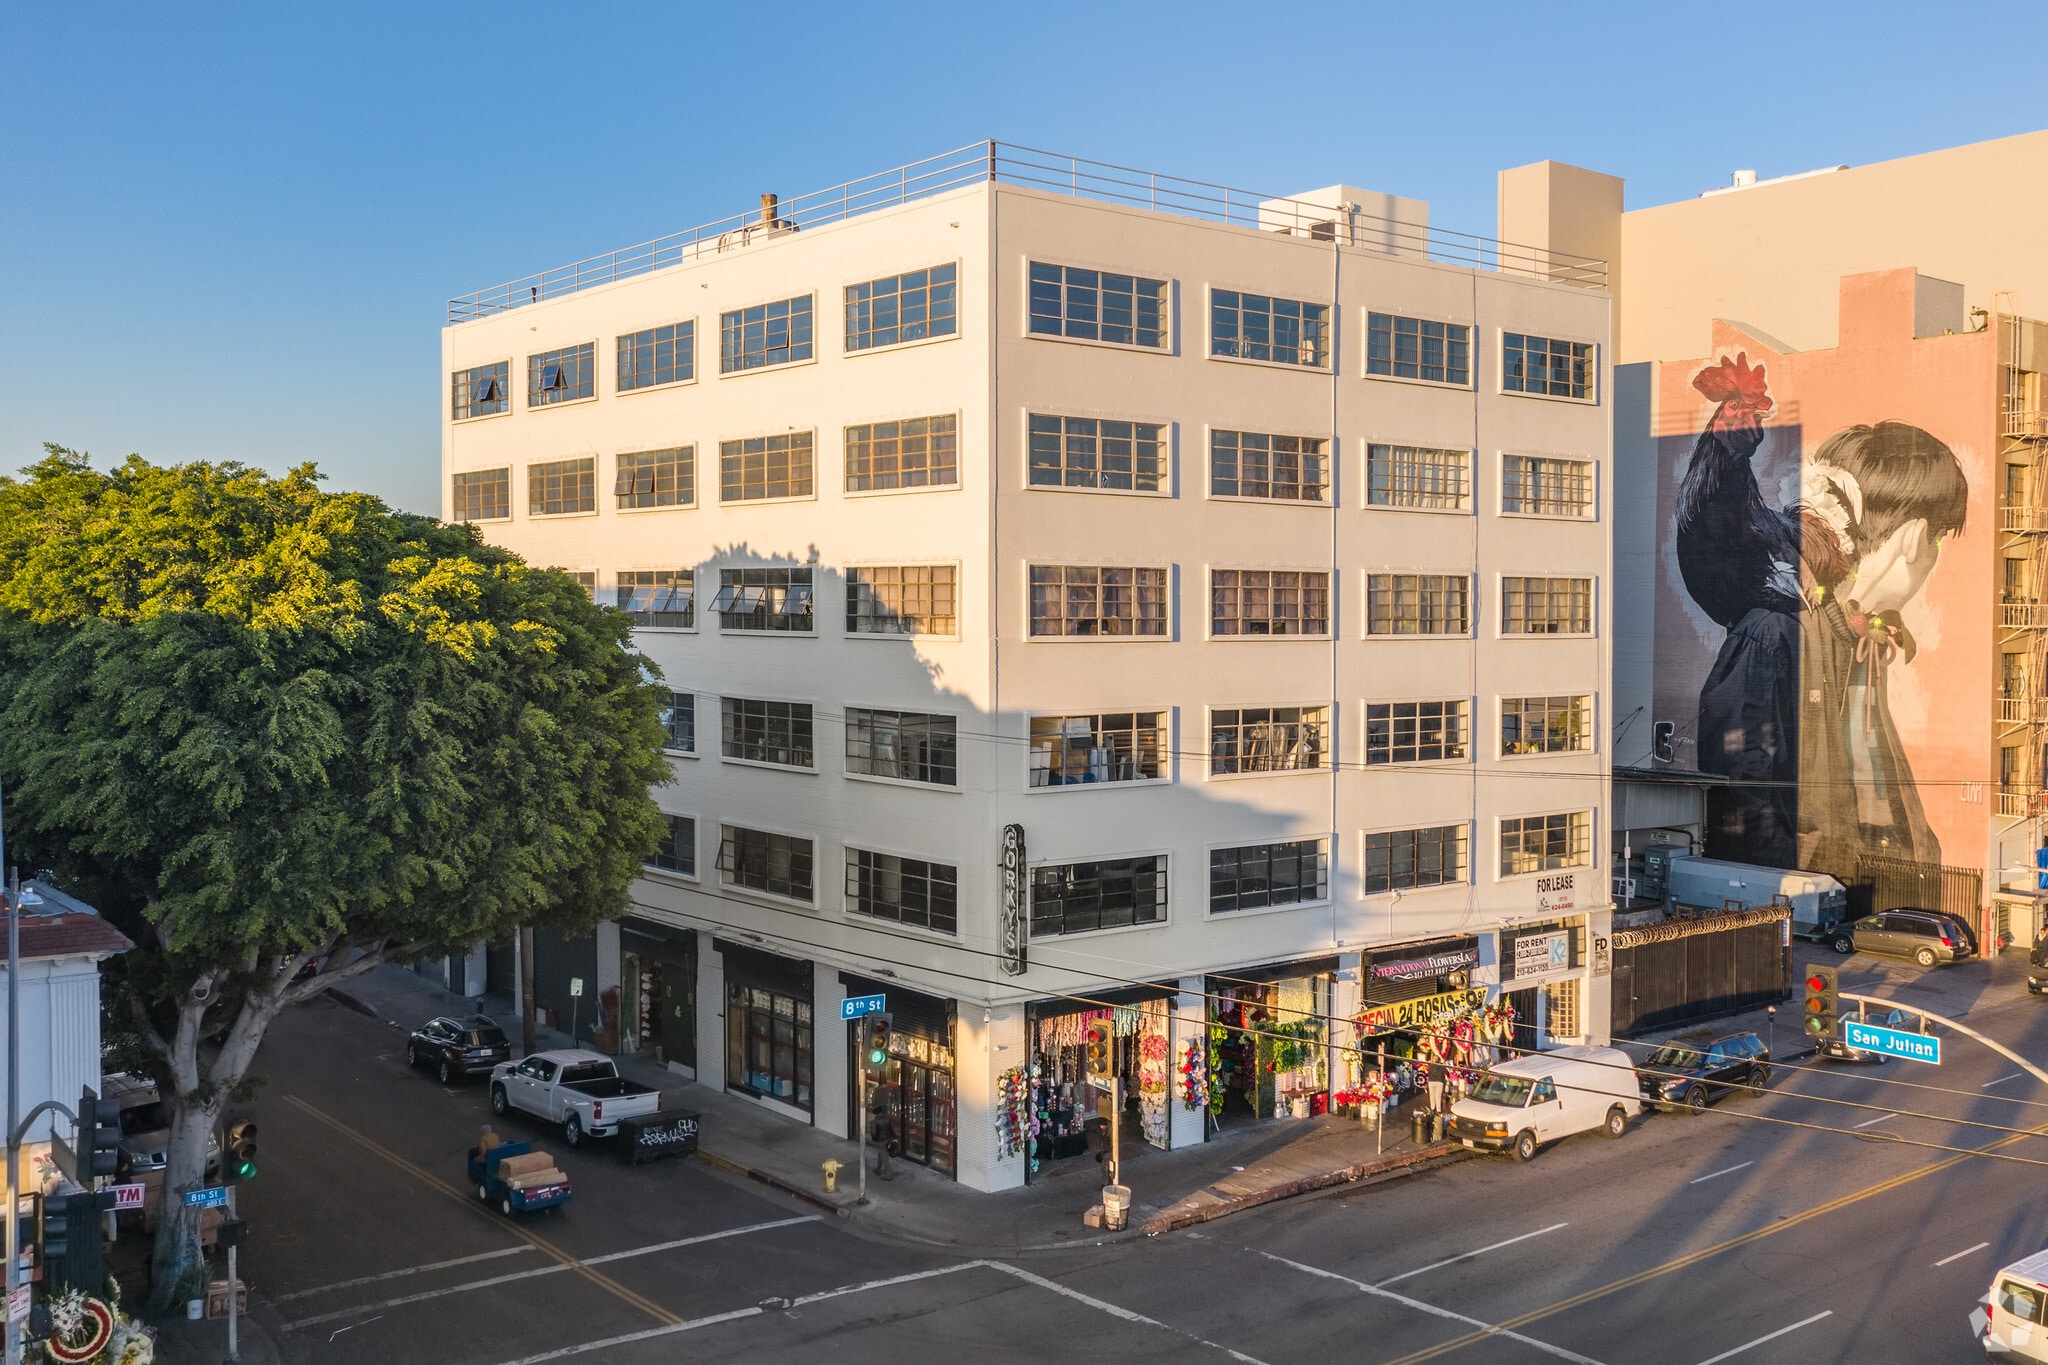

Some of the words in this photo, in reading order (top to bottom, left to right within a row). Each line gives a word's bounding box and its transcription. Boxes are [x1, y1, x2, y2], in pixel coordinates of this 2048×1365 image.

[1005, 831, 1016, 949] GORKY'S
[1537, 878, 1551, 893] FOR
[1552, 875, 1573, 891] LEASE
[1516, 940, 1530, 950] FOR
[1531, 937, 1548, 947] RENT
[1595, 938, 1607, 951] FD
[845, 1000, 866, 1016] 8th
[868, 999, 881, 1011] St
[1399, 1004, 1413, 1027] 24
[1852, 1028, 1880, 1047] San
[1885, 1035, 1933, 1057] Julian
[116, 1188, 141, 1203] TM
[191, 1193, 206, 1202] 8th
[208, 1190, 218, 1199] St
